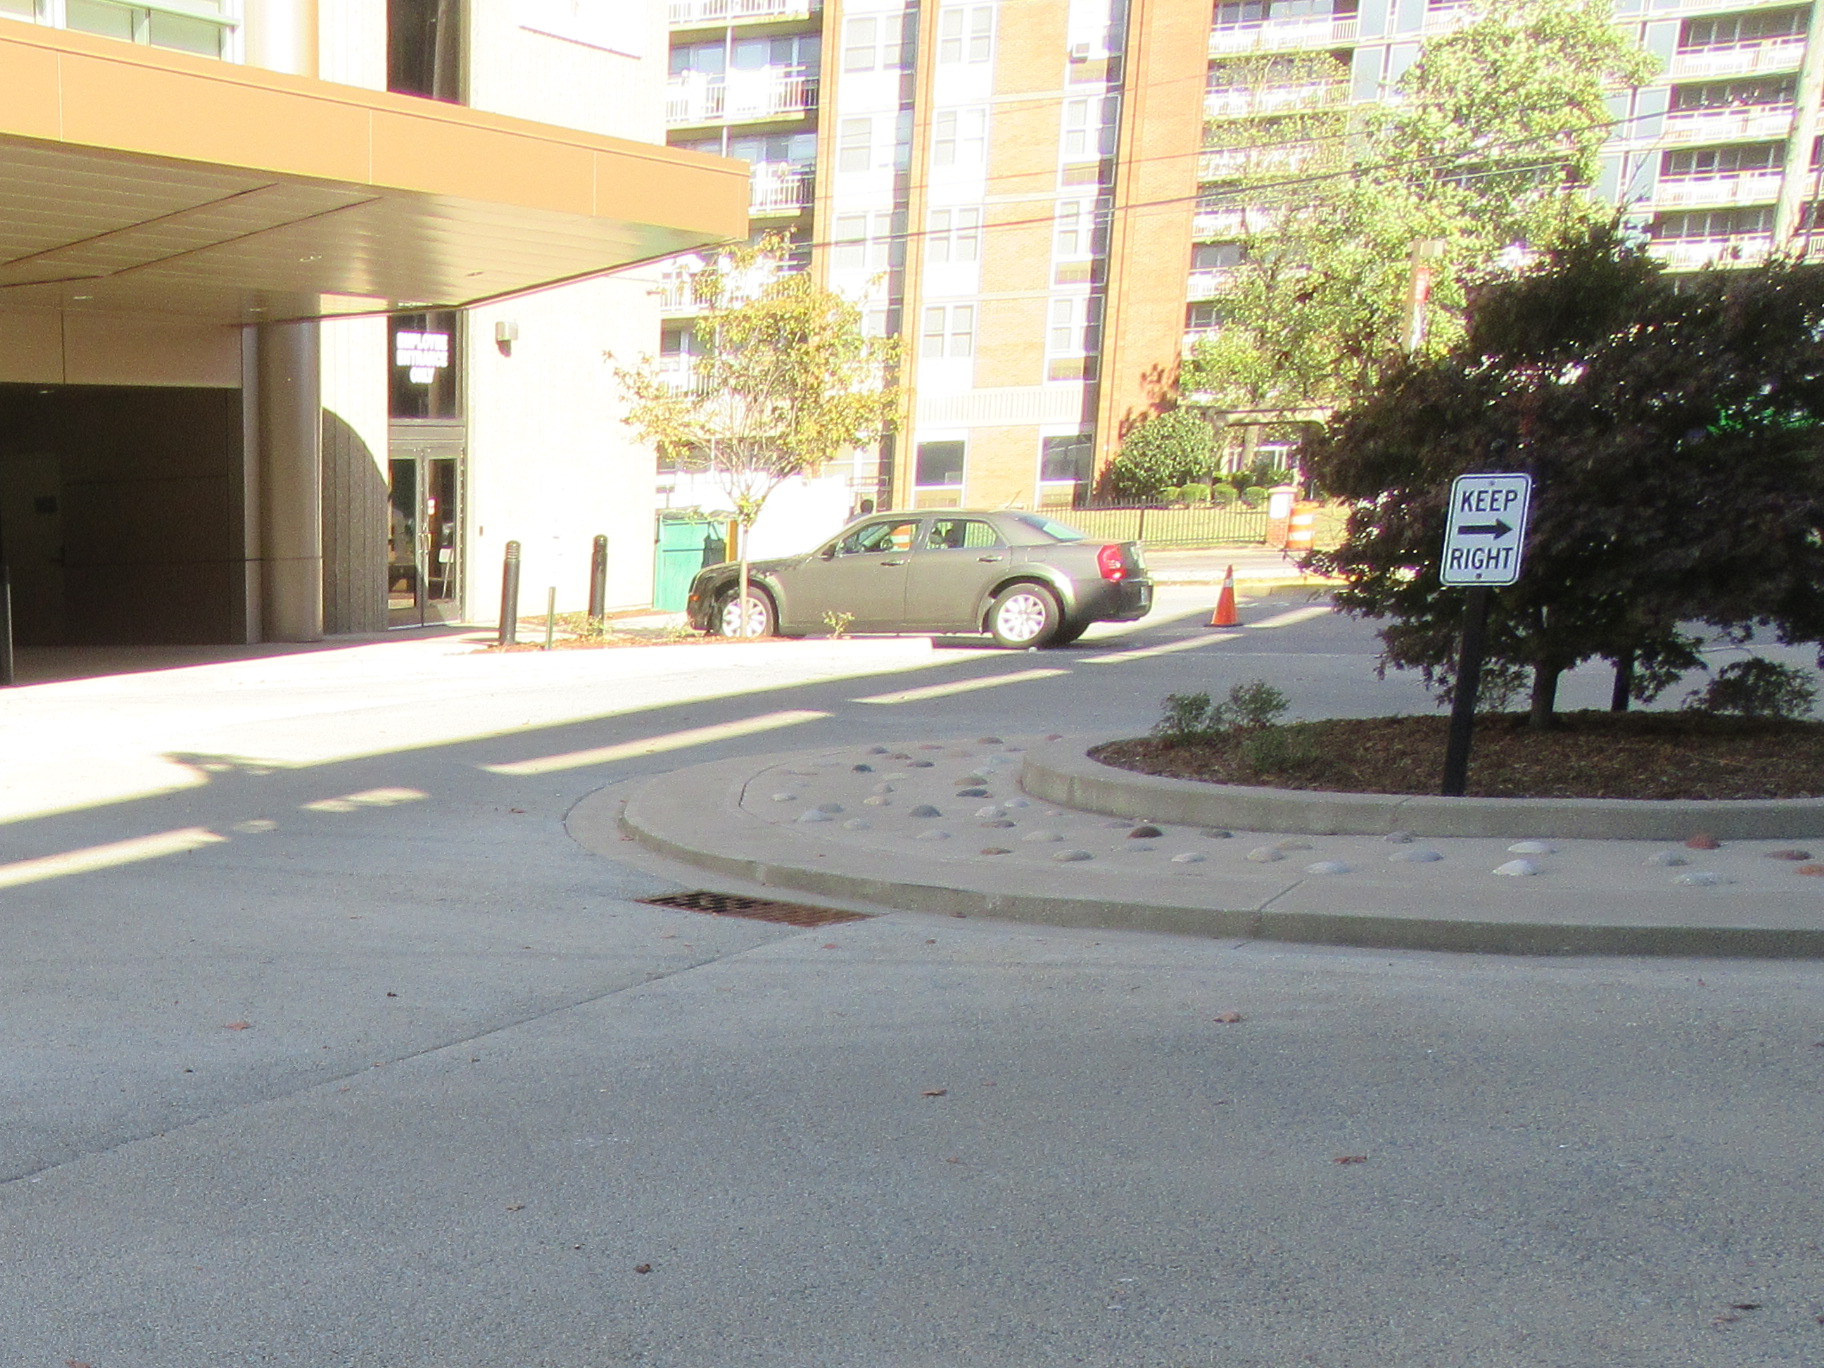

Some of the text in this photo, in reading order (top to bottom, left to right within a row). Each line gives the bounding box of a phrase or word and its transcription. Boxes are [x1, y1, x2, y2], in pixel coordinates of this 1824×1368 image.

[397, 332, 447, 350] EMPLOYEE
[397, 349, 447, 367] ENTRANCE
[410, 366, 435, 383] ONLY
[1460, 489, 1518, 513] KEEP
[1449, 547, 1514, 570] RIGHT
